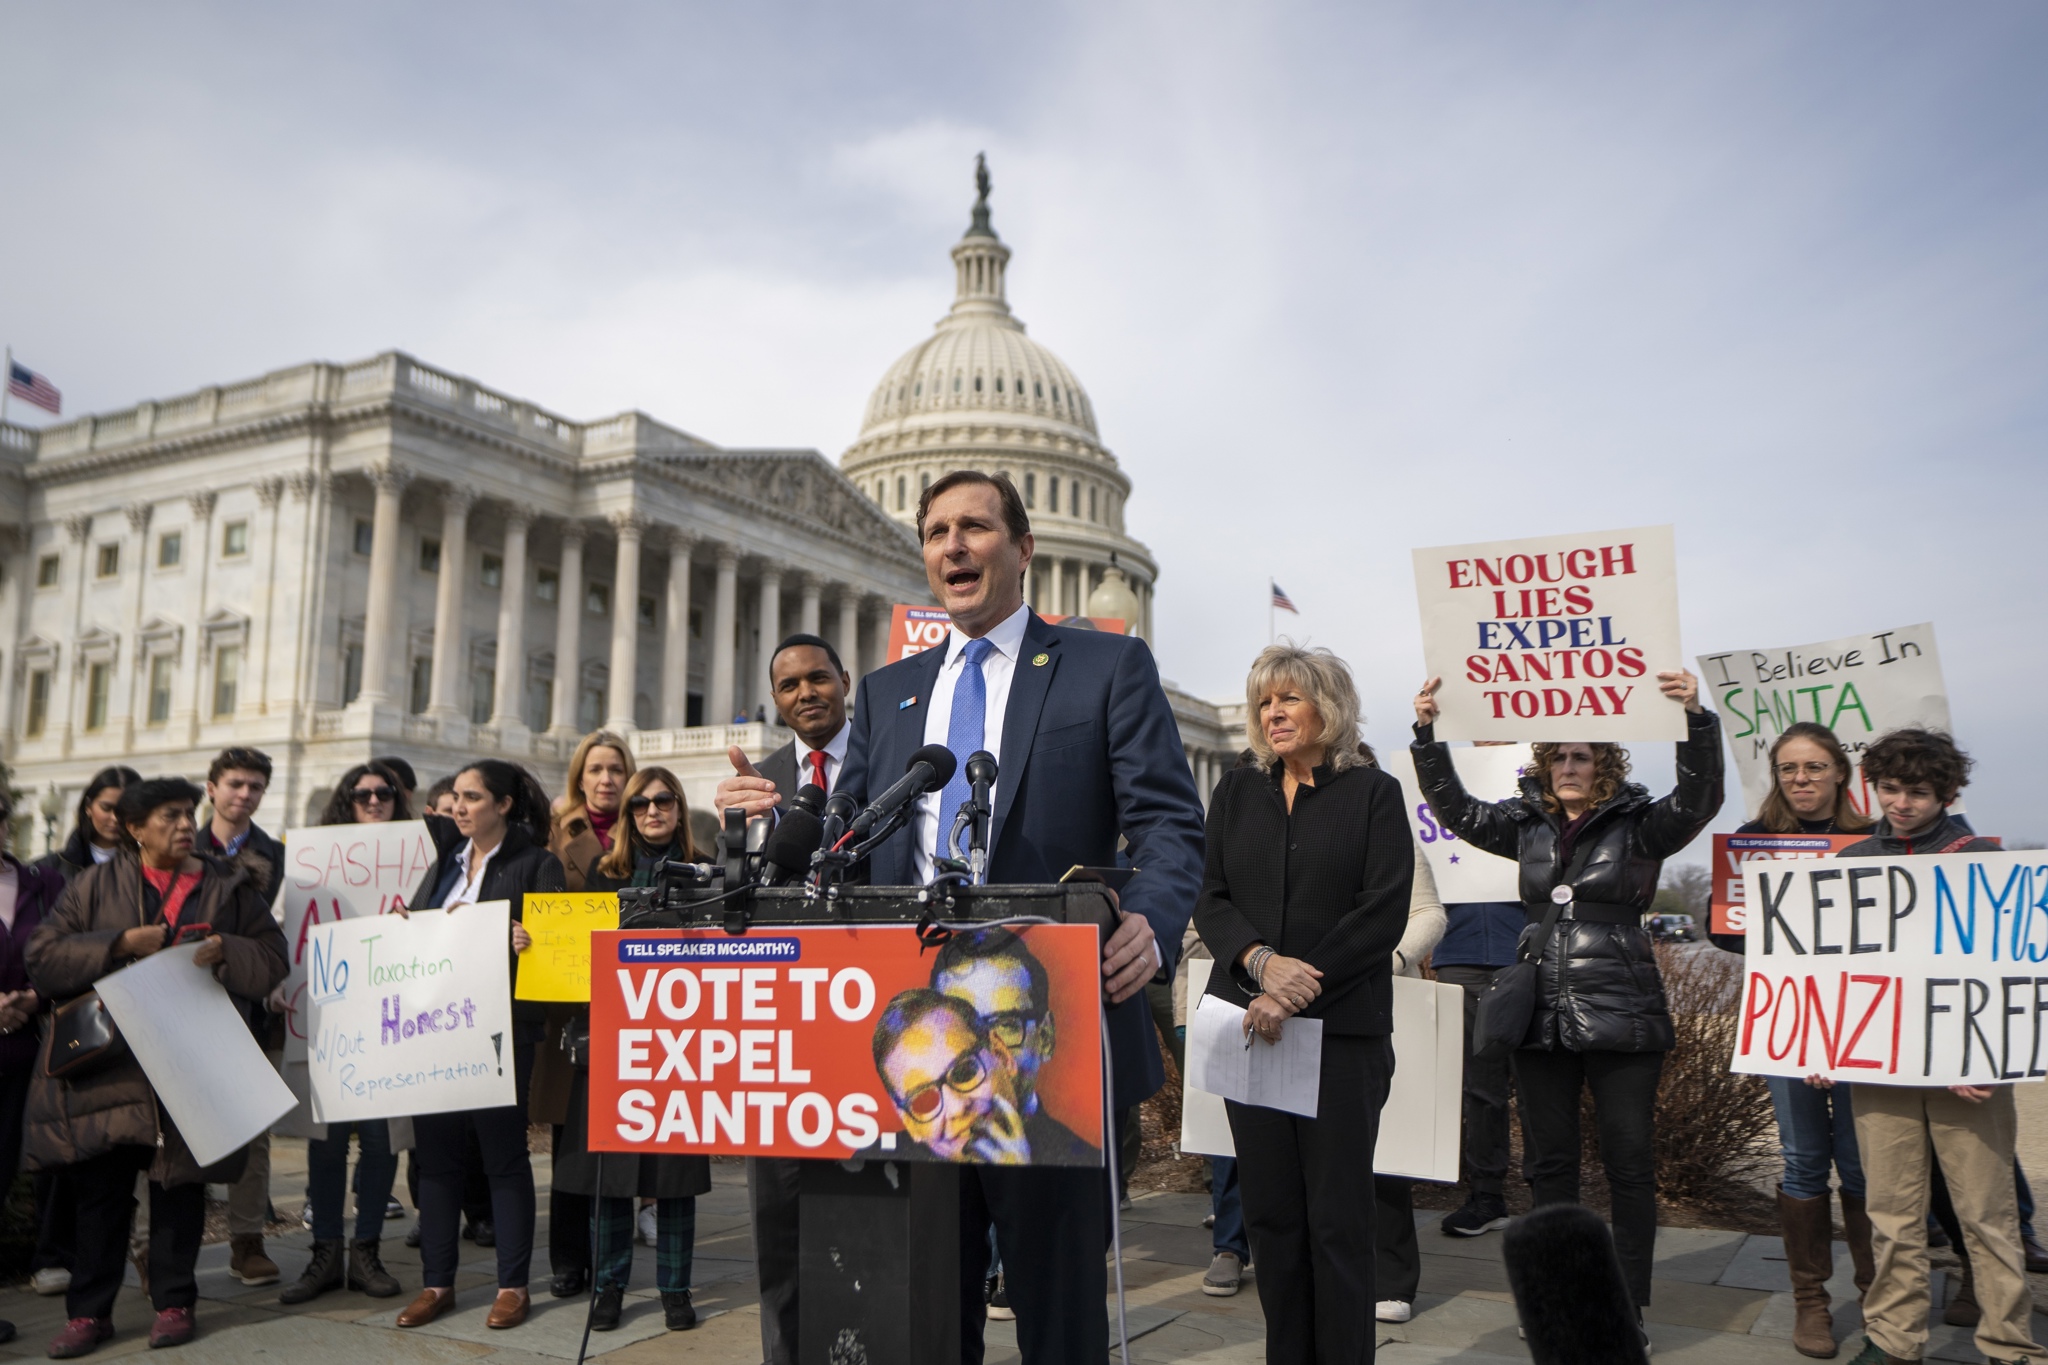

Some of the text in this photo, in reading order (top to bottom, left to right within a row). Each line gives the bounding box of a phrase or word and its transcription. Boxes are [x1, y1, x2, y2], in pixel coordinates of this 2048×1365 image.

[1446, 544, 1637, 588] ENOUGH
[1493, 585, 1594, 619] LIES
[1476, 616, 1627, 650] EXPEL
[1708, 632, 1922, 687] I Believe In
[1466, 647, 1647, 683] SANTOS
[1483, 686, 1634, 719] TODAY
[1724, 681, 1873, 738] SANTA
[295, 834, 431, 891] SASHA
[1749, 839, 1783, 847] SPEAKER
[530, 899, 573, 915] NY-3
[1759, 865, 1918, 955] KEEP
[313, 928, 349, 997] No
[360, 934, 454, 987] Taxation
[625, 942, 795, 956] TELL SPEAKER MCCARTHY:
[380, 994, 476, 1046] Honest
[617, 967, 876, 1022] VOTE TO
[1740, 971, 2048, 1080] PONZI FREE
[617, 1028, 811, 1083] EXPEL
[616, 1089, 897, 1149] SANTOS.
